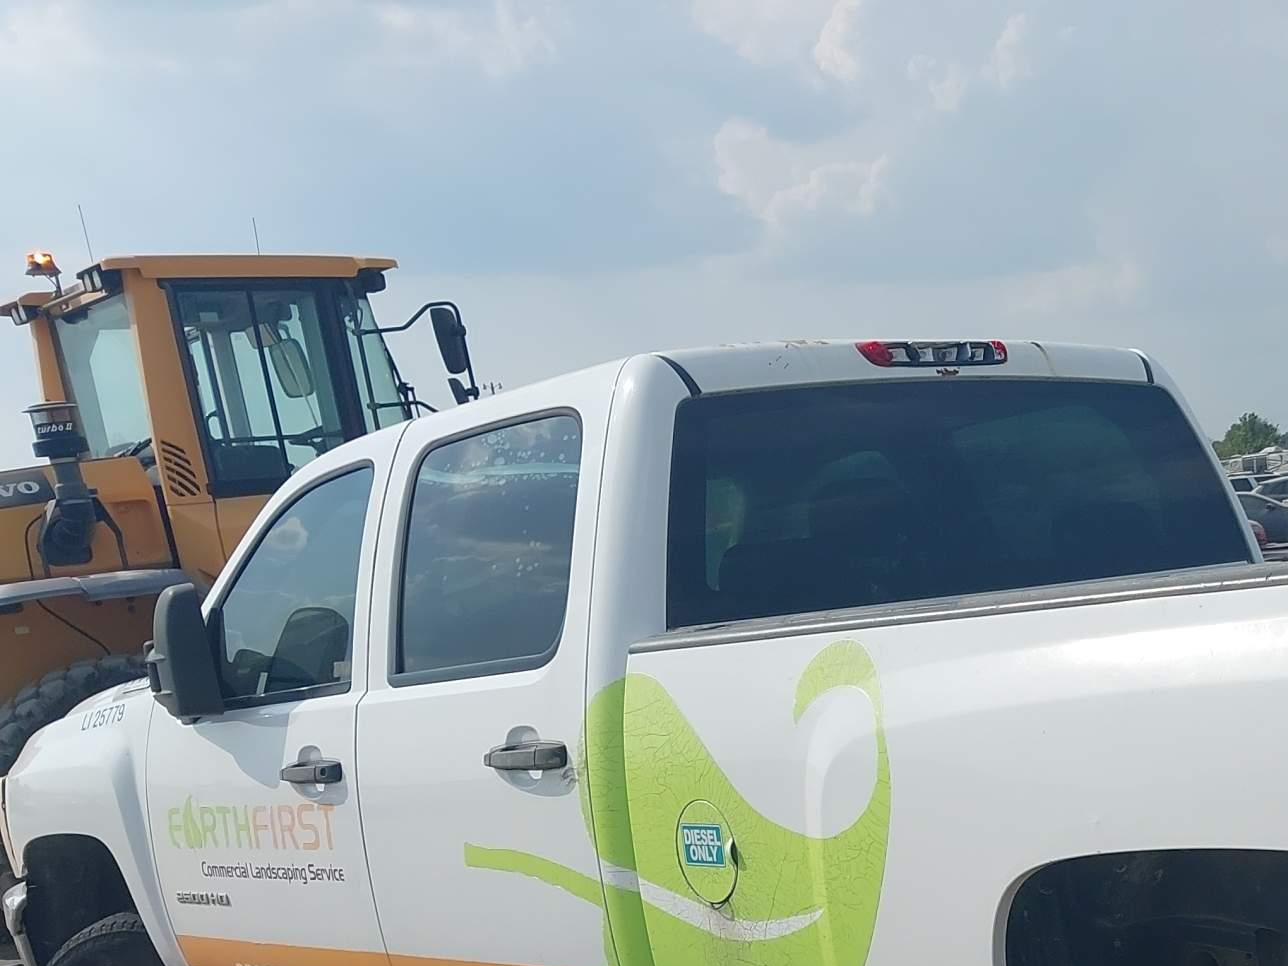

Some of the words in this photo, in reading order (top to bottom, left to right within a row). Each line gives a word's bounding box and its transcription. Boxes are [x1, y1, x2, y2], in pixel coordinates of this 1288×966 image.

[37, 424, 64, 434] turbo
[92, 704, 126, 728] 25779
[683, 829, 721, 846] DIESEL
[689, 845, 718, 862] ONLY
[201, 861, 249, 879] Commercial
[250, 863, 307, 885] Landscaping
[307, 863, 345, 882] Service
